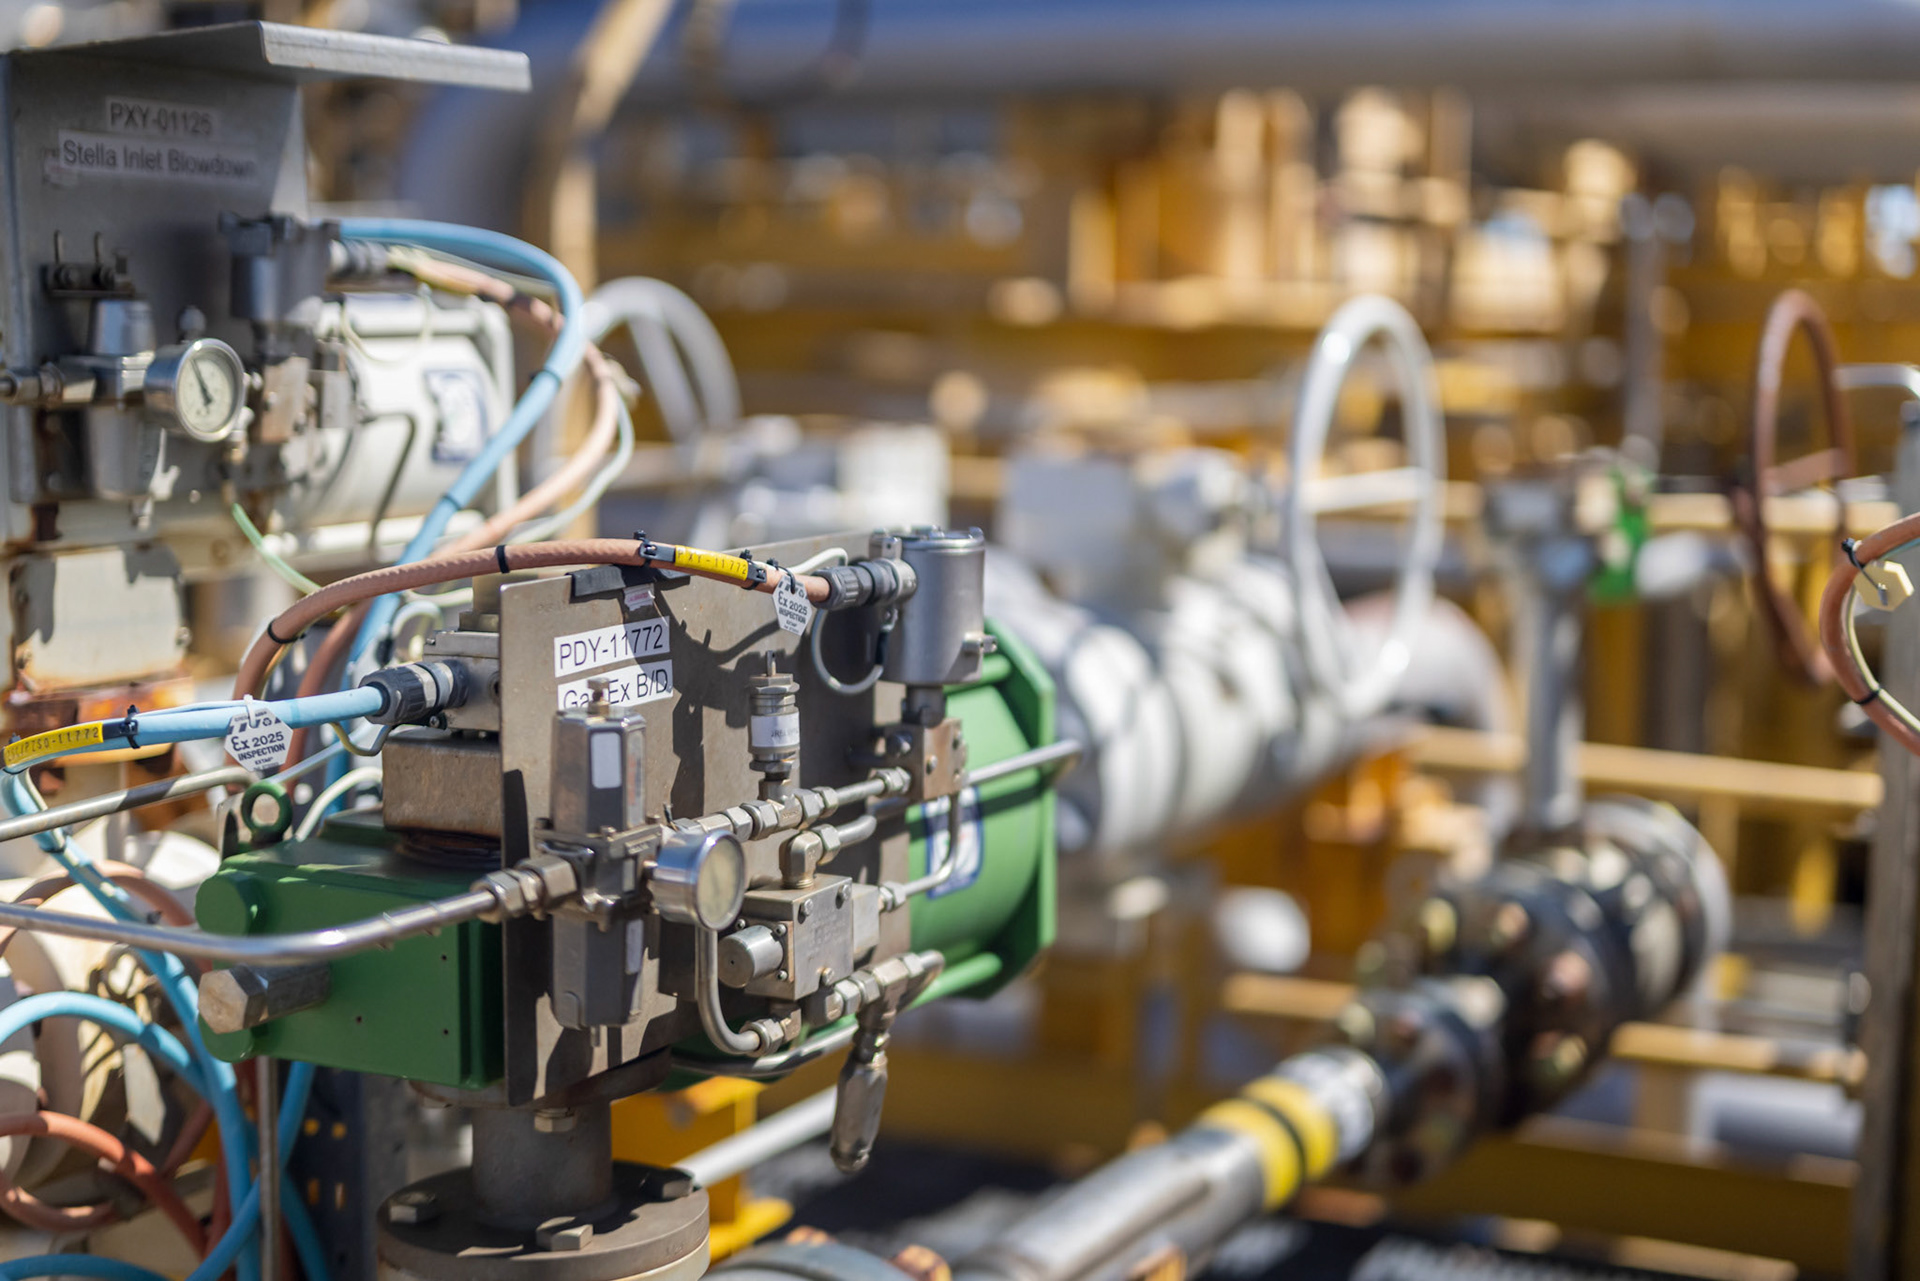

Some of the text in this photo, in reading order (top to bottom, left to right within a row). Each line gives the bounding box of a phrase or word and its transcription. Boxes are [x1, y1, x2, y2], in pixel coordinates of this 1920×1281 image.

[110, 103, 213, 135] PXY-01125
[62, 139, 258, 178] Stella Inlet Blowdown
[789, 601, 807, 615] 2025
[560, 624, 664, 669] PDY-11772
[563, 669, 668, 710] Ga Ex B/D
[231, 731, 284, 751] Ex 2025
[238, 743, 286, 760] INSPECTION
